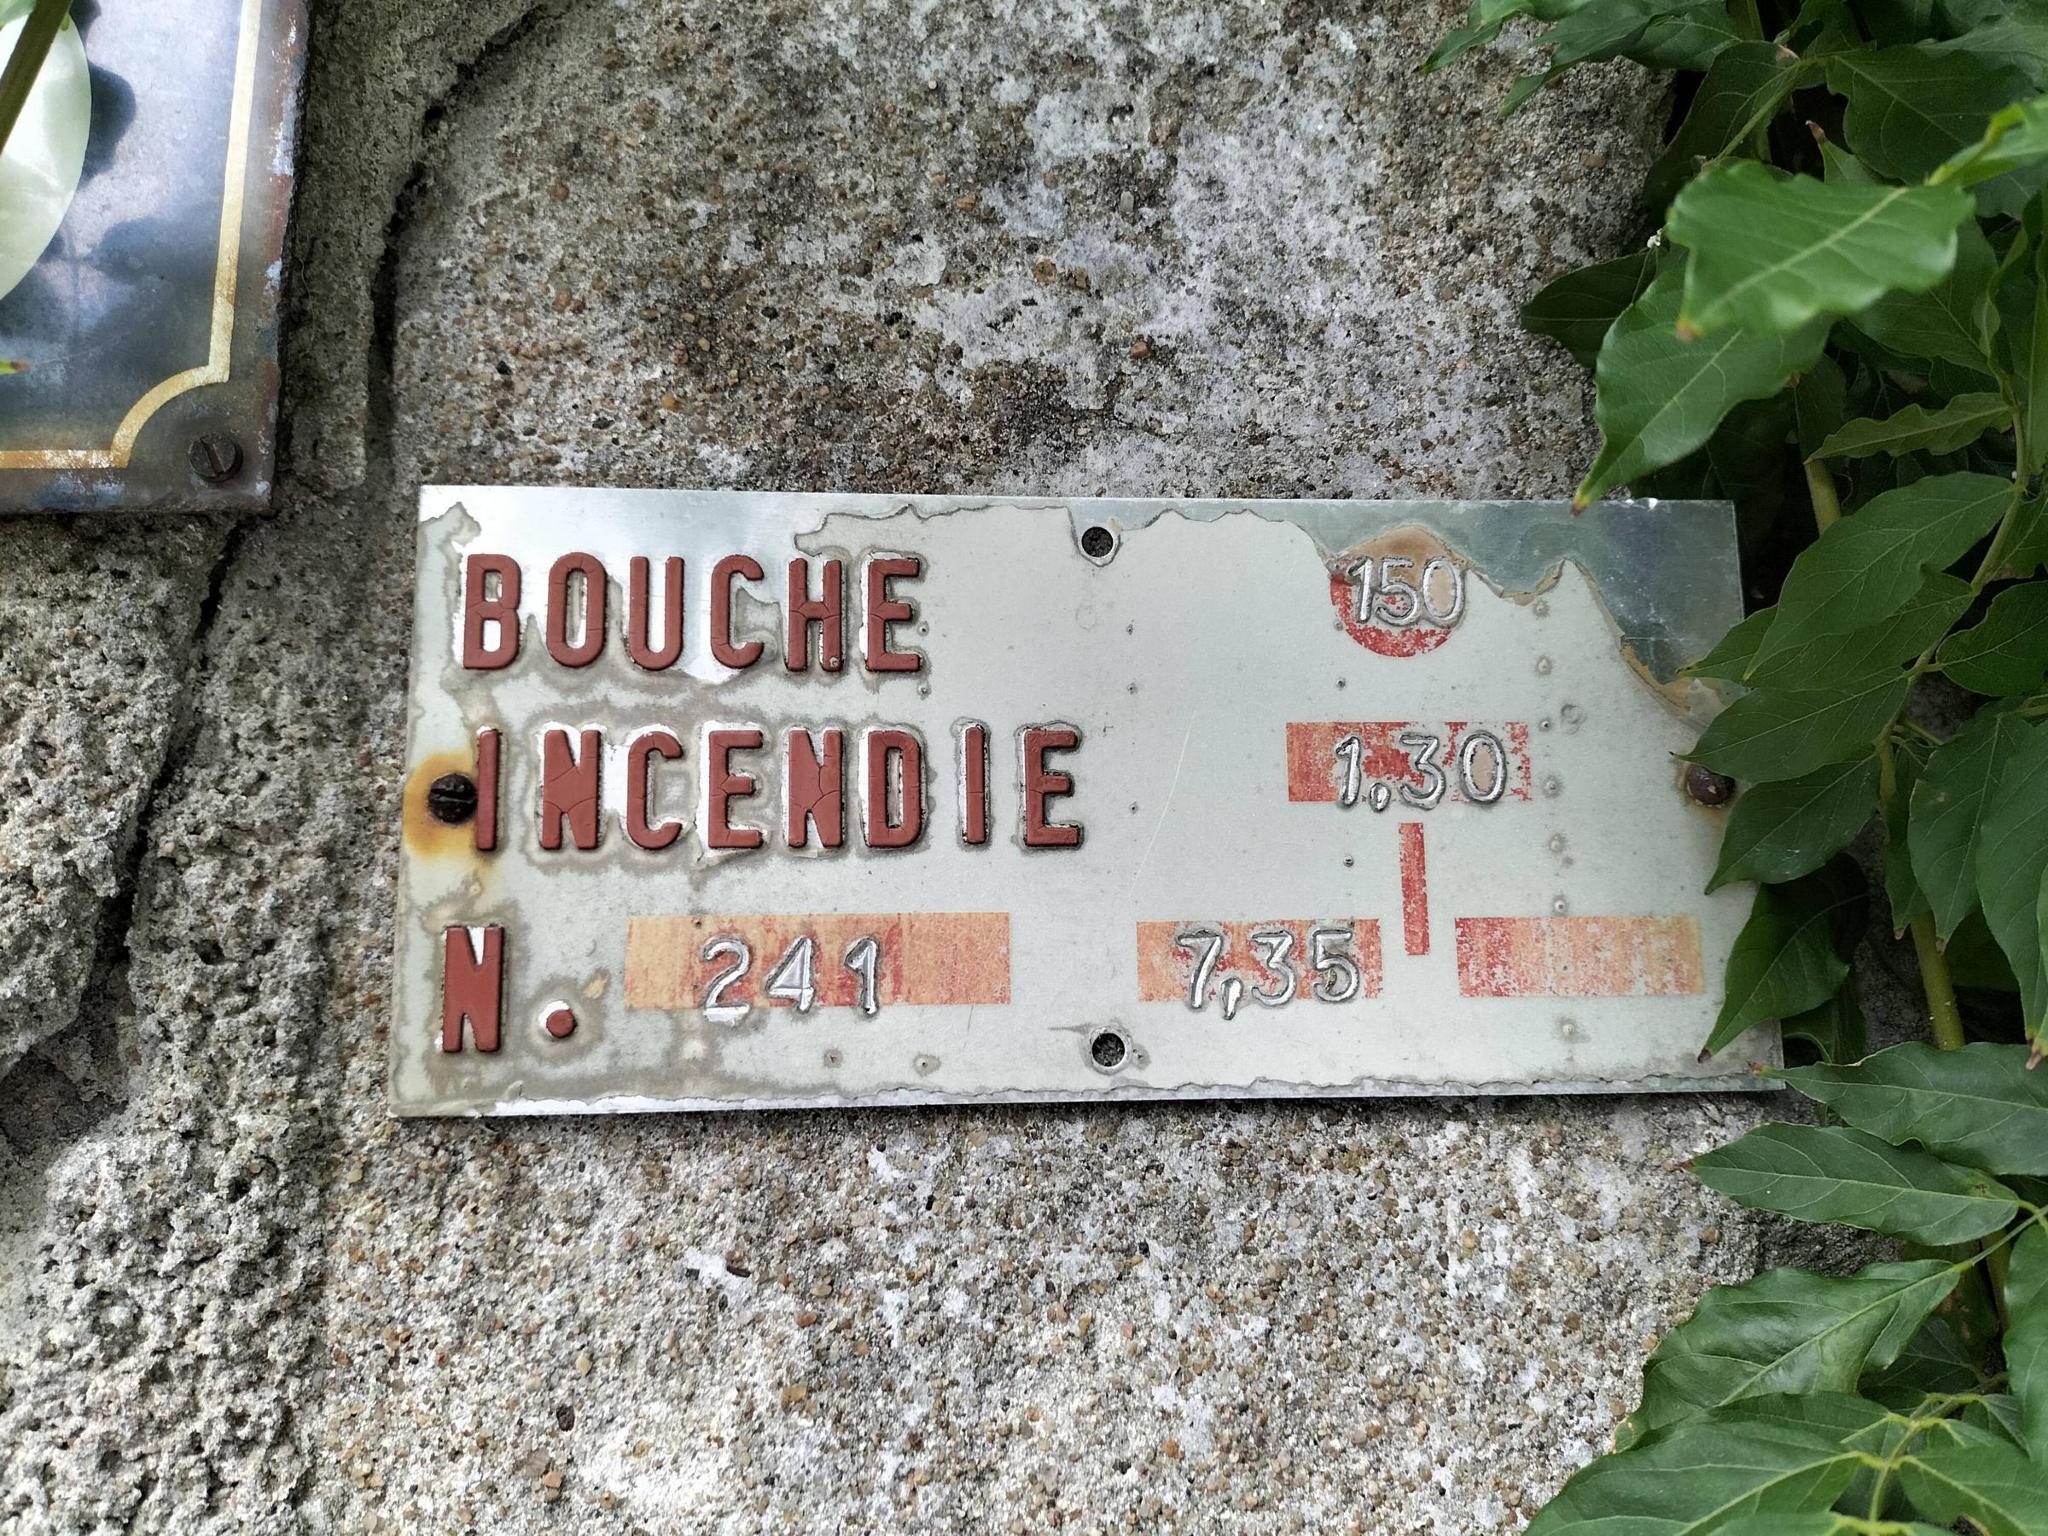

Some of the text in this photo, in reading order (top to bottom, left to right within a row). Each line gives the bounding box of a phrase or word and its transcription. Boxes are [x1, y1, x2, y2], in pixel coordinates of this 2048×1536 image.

[462, 553, 922, 673] BOUCHE
[1346, 556, 1465, 627] 150
[475, 726, 1083, 852] INCENDIE
[441, 925, 881, 1053] N. 241
[1175, 925, 1360, 1020] 7,35
